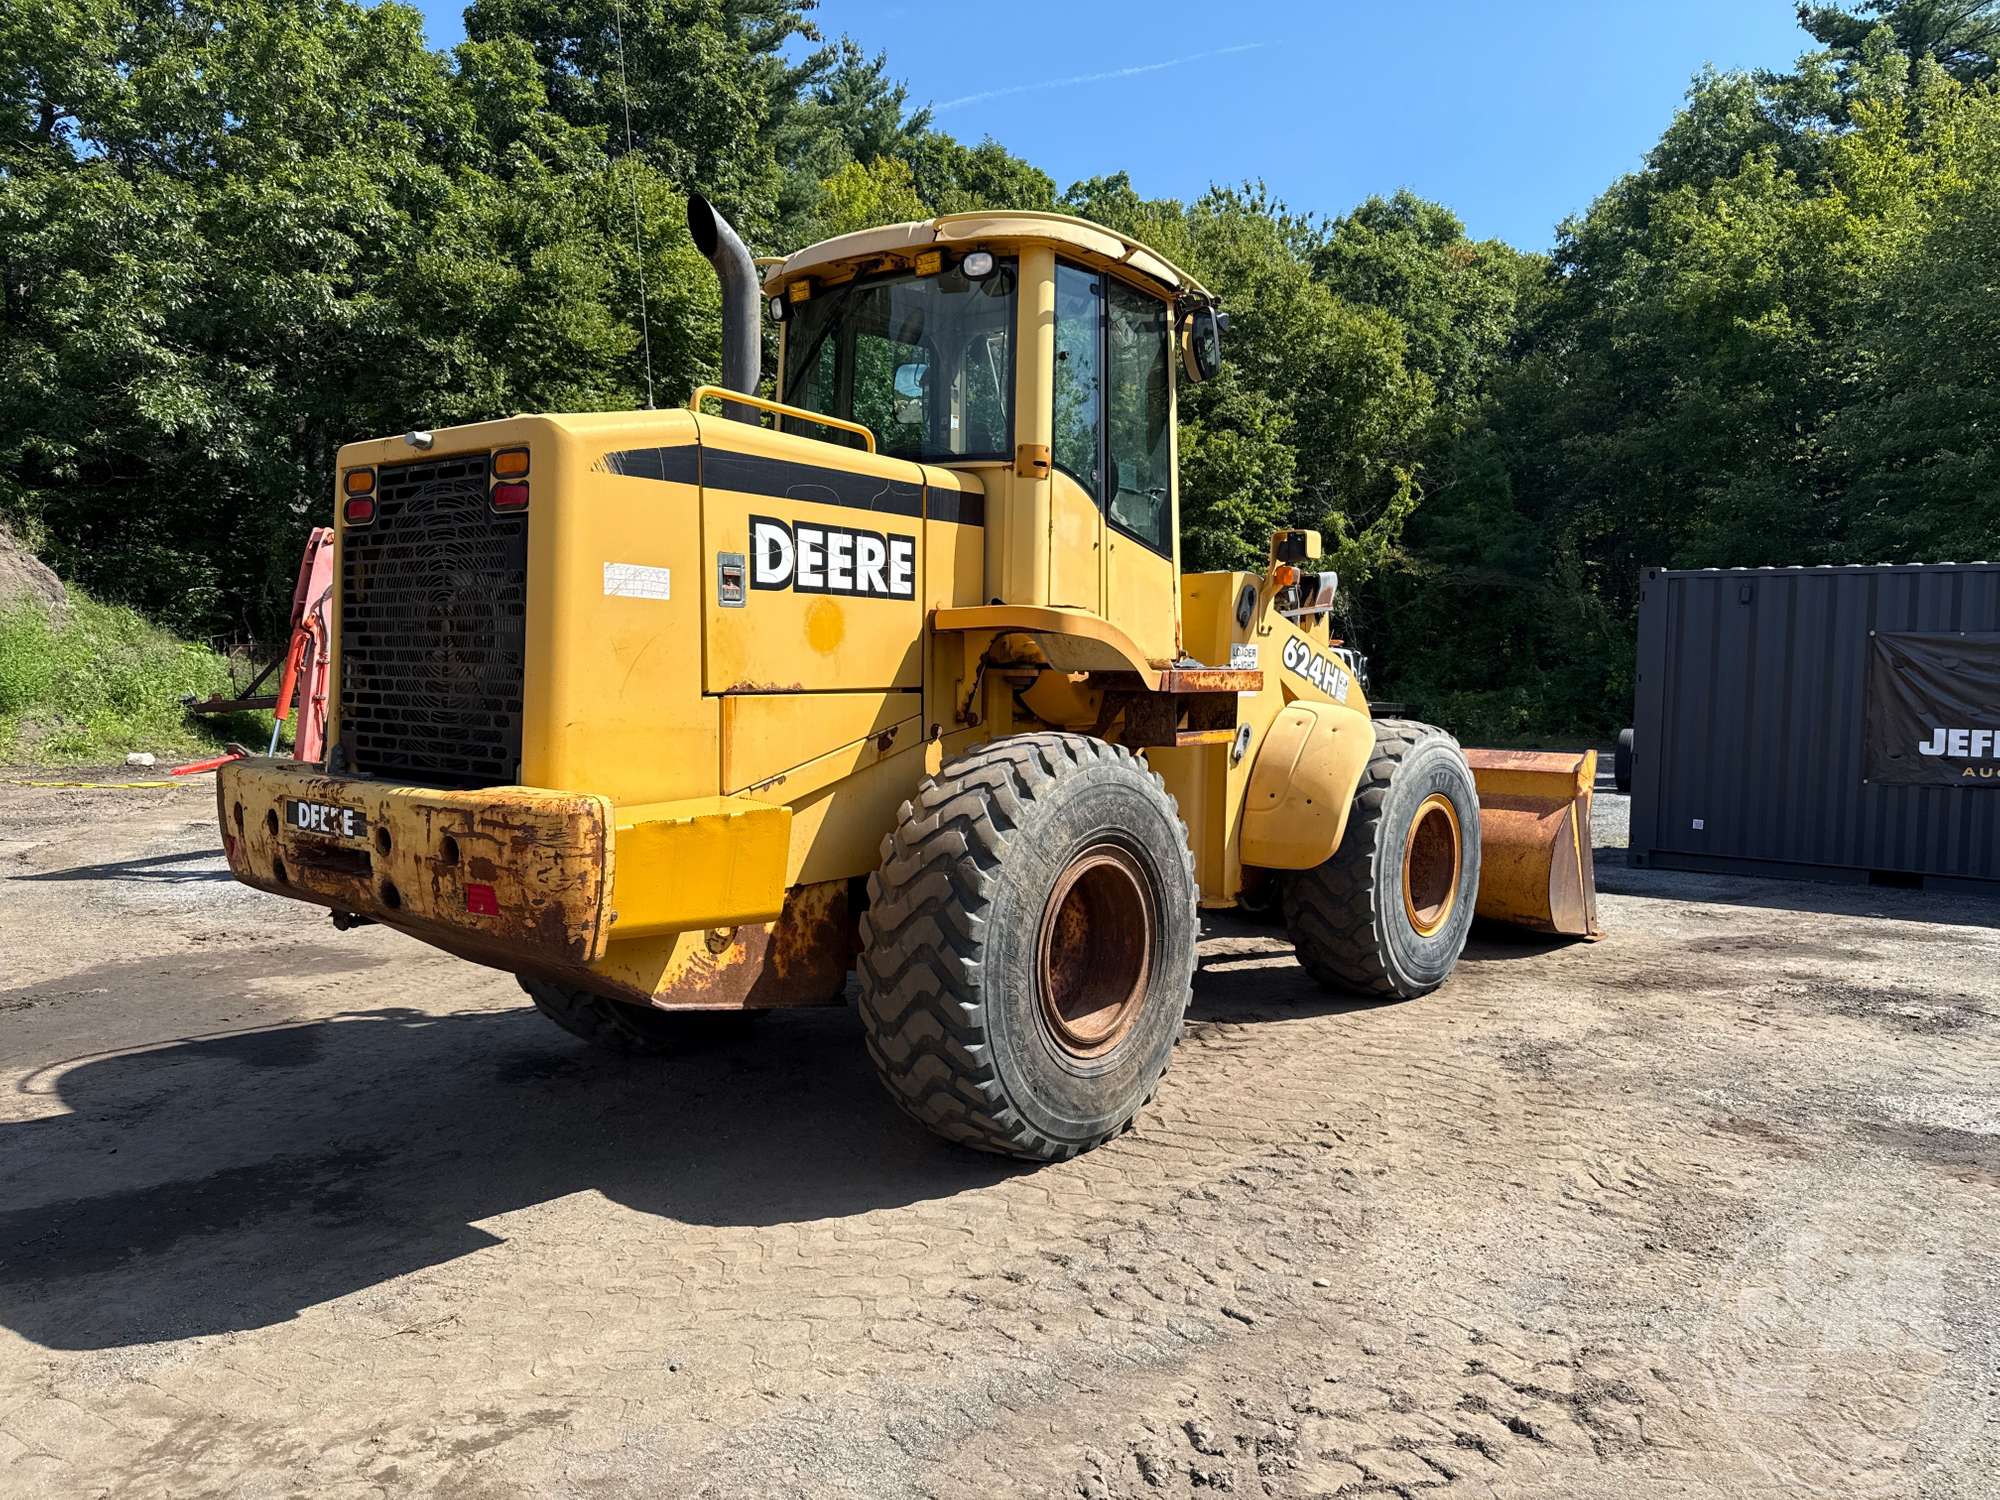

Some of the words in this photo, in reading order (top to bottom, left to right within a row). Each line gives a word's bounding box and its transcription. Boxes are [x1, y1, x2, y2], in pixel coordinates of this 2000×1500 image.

[752, 518, 914, 597] DEERE
[1282, 635, 1340, 699] 624H
[1919, 728, 2000, 758] JEF
[1962, 767, 2000, 778] AU
